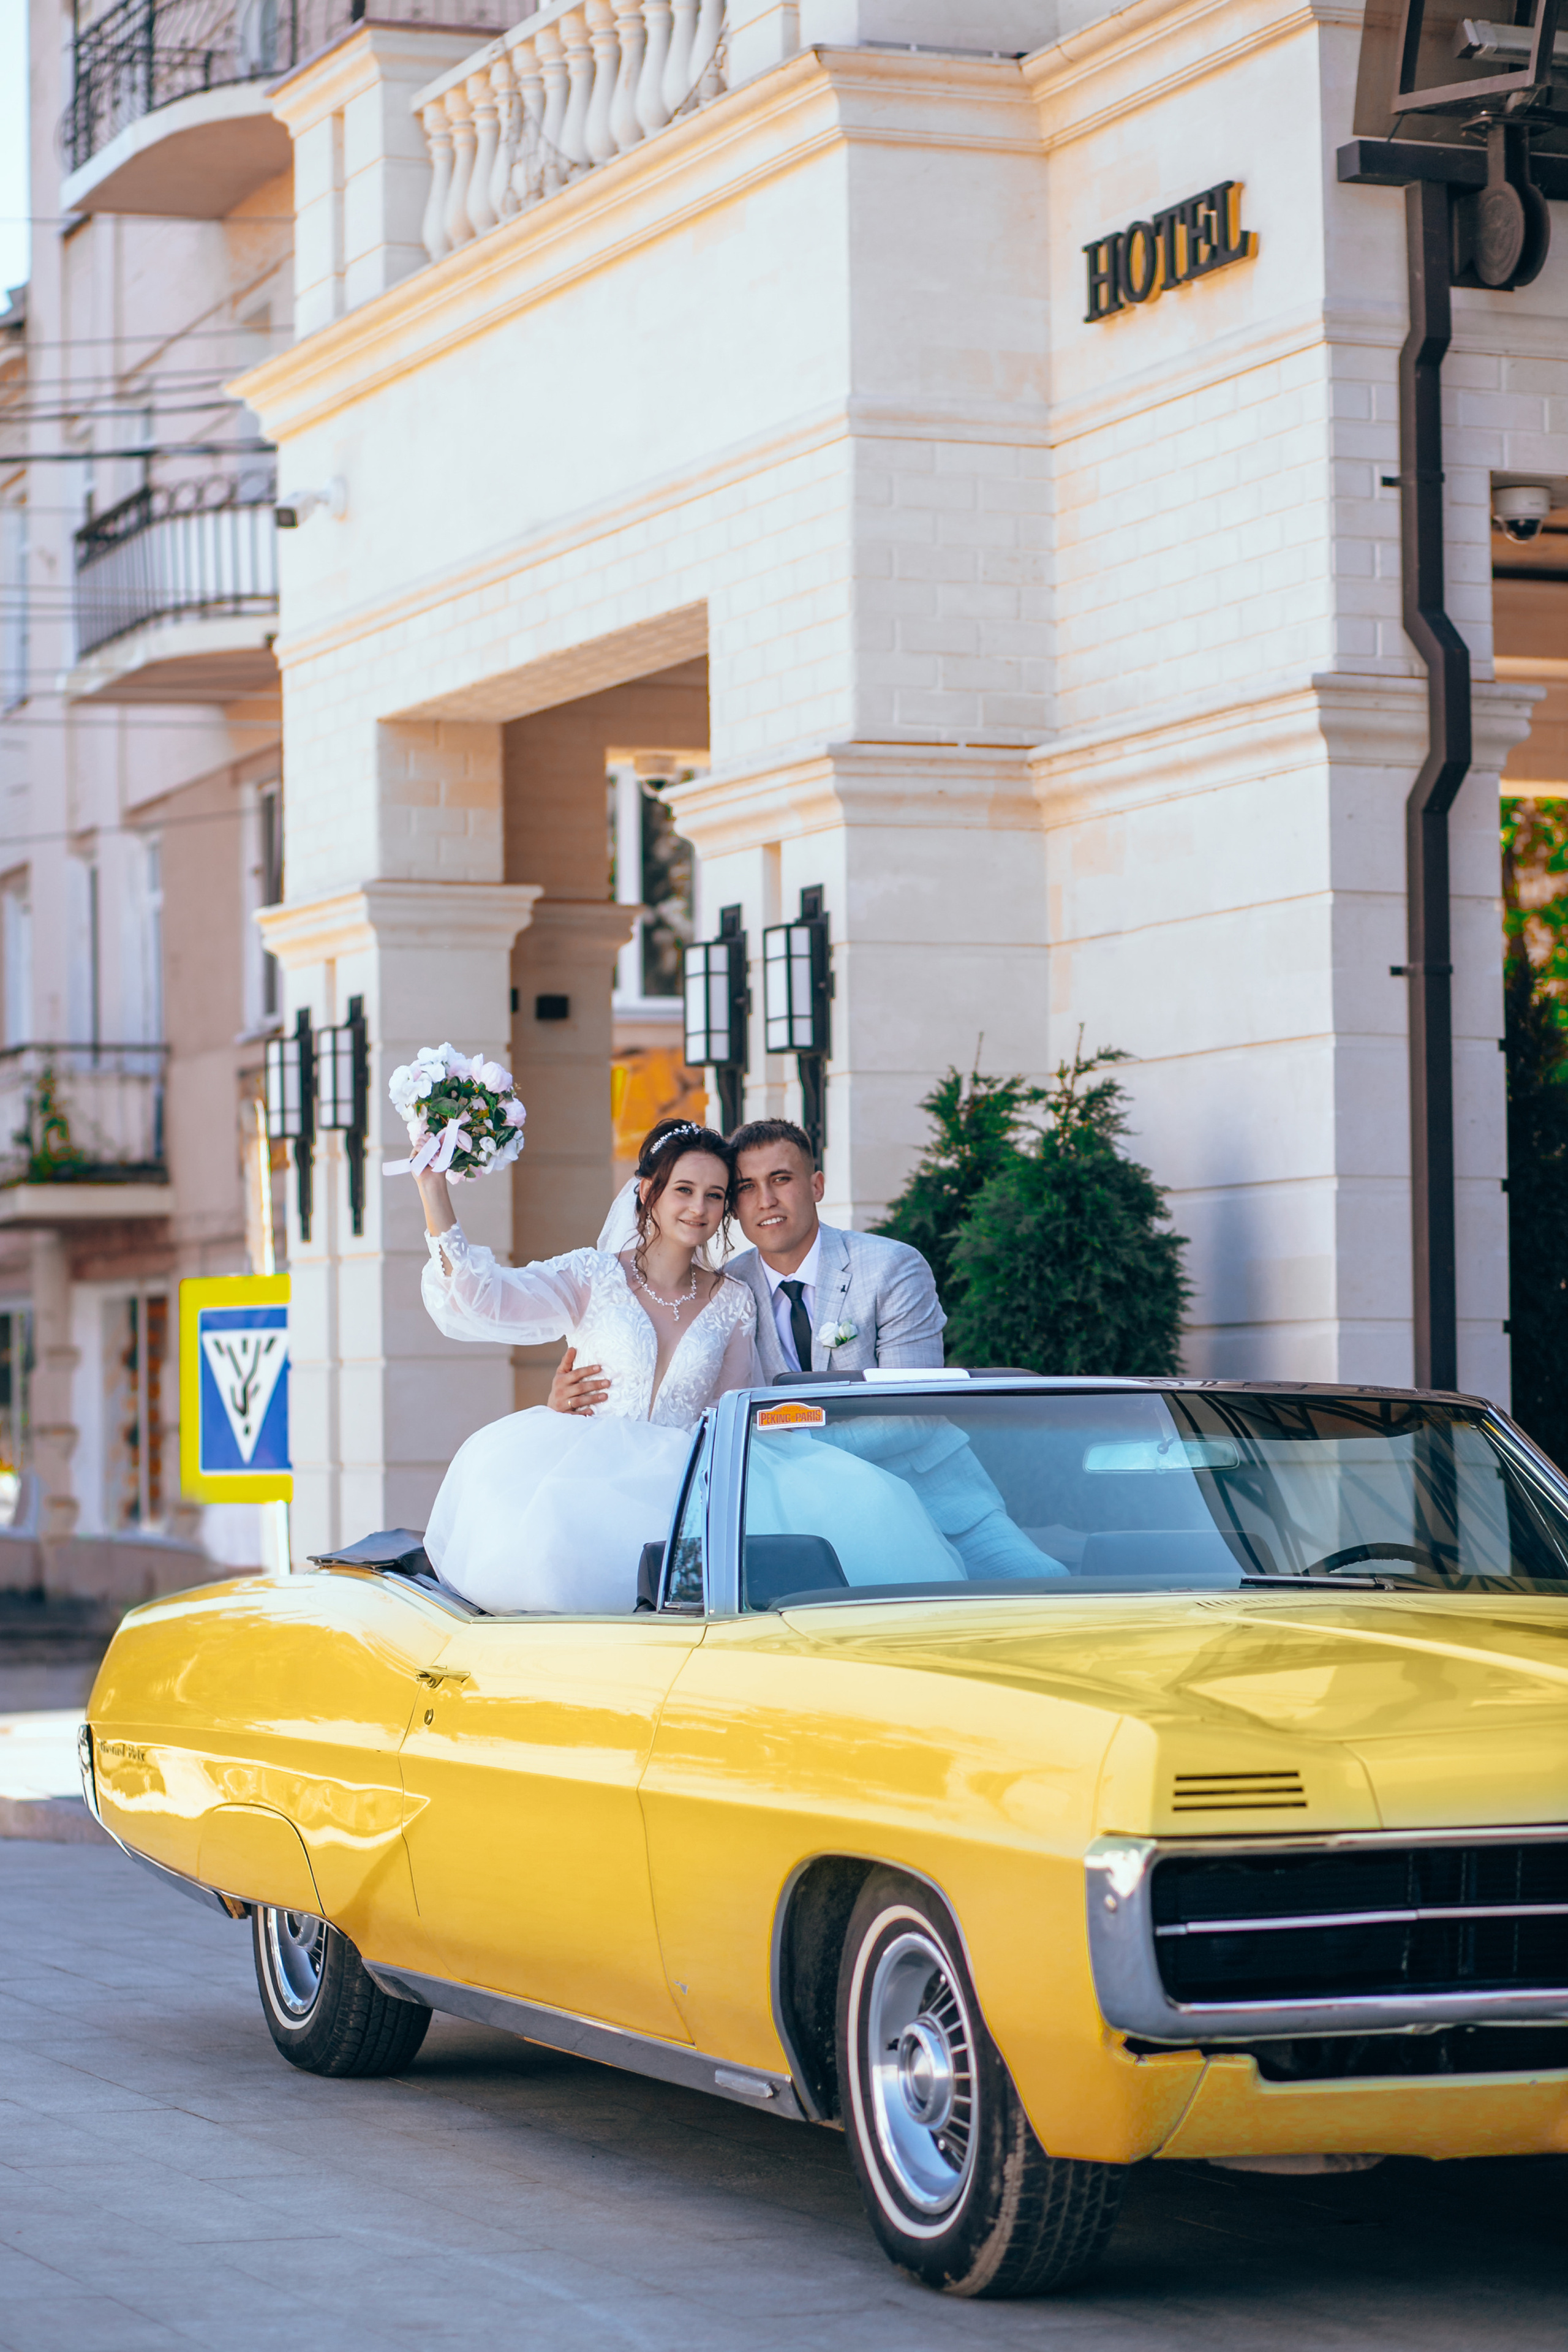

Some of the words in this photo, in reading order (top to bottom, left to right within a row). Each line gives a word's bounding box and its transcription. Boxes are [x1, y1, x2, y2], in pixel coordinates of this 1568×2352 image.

[1083, 180, 1254, 323] HOTEL
[761, 1413, 791, 1425] PEKING
[796, 1410, 821, 1422] PARIS
